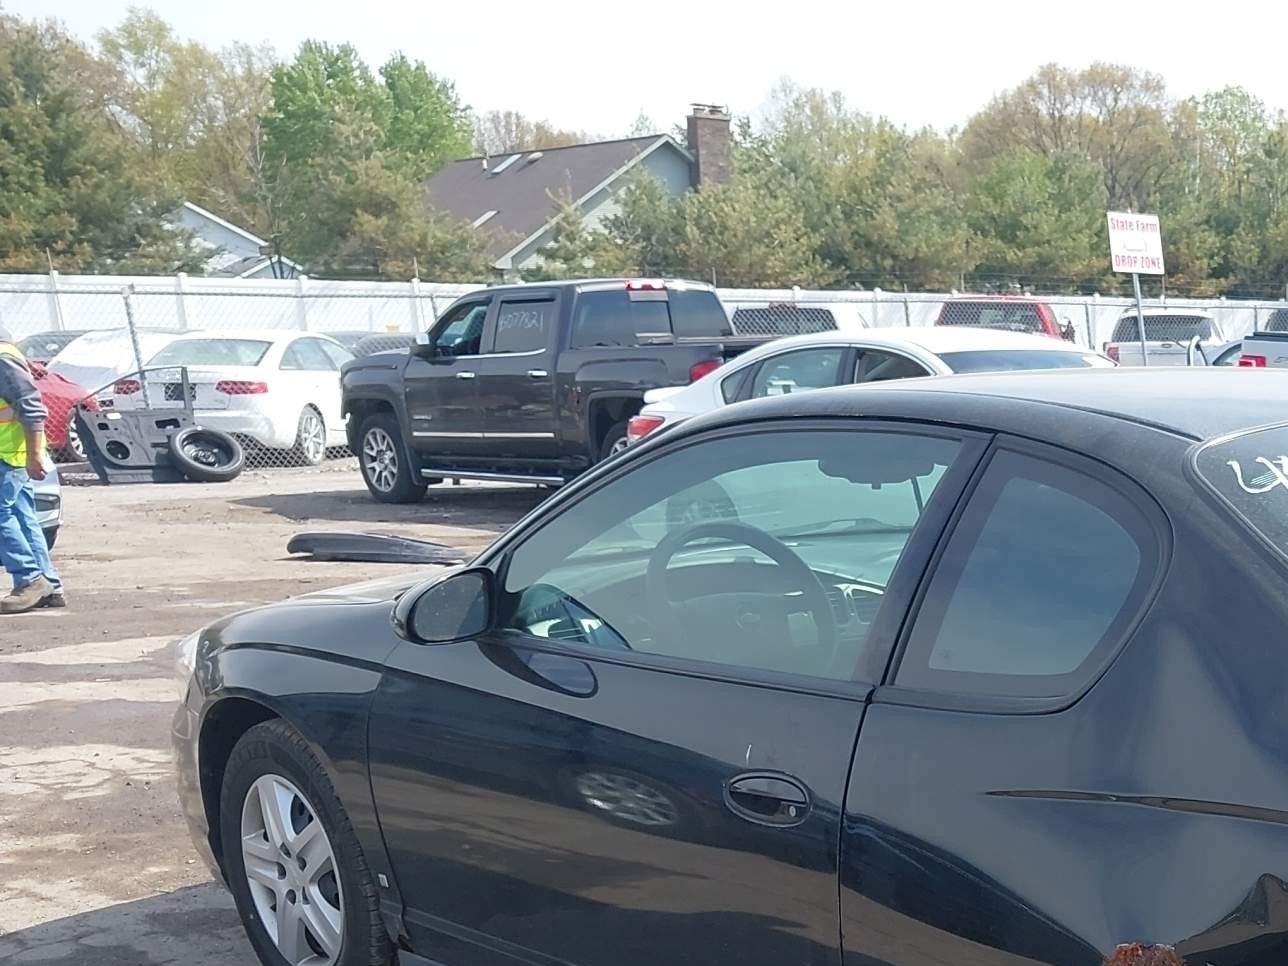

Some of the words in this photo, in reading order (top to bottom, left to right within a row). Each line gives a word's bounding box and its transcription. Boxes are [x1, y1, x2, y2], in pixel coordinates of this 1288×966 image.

[1110, 217, 1134, 231] State
[1135, 220, 1158, 233] Farm
[1115, 254, 1138, 268] DROP
[1140, 255, 1161, 270] ZONE
